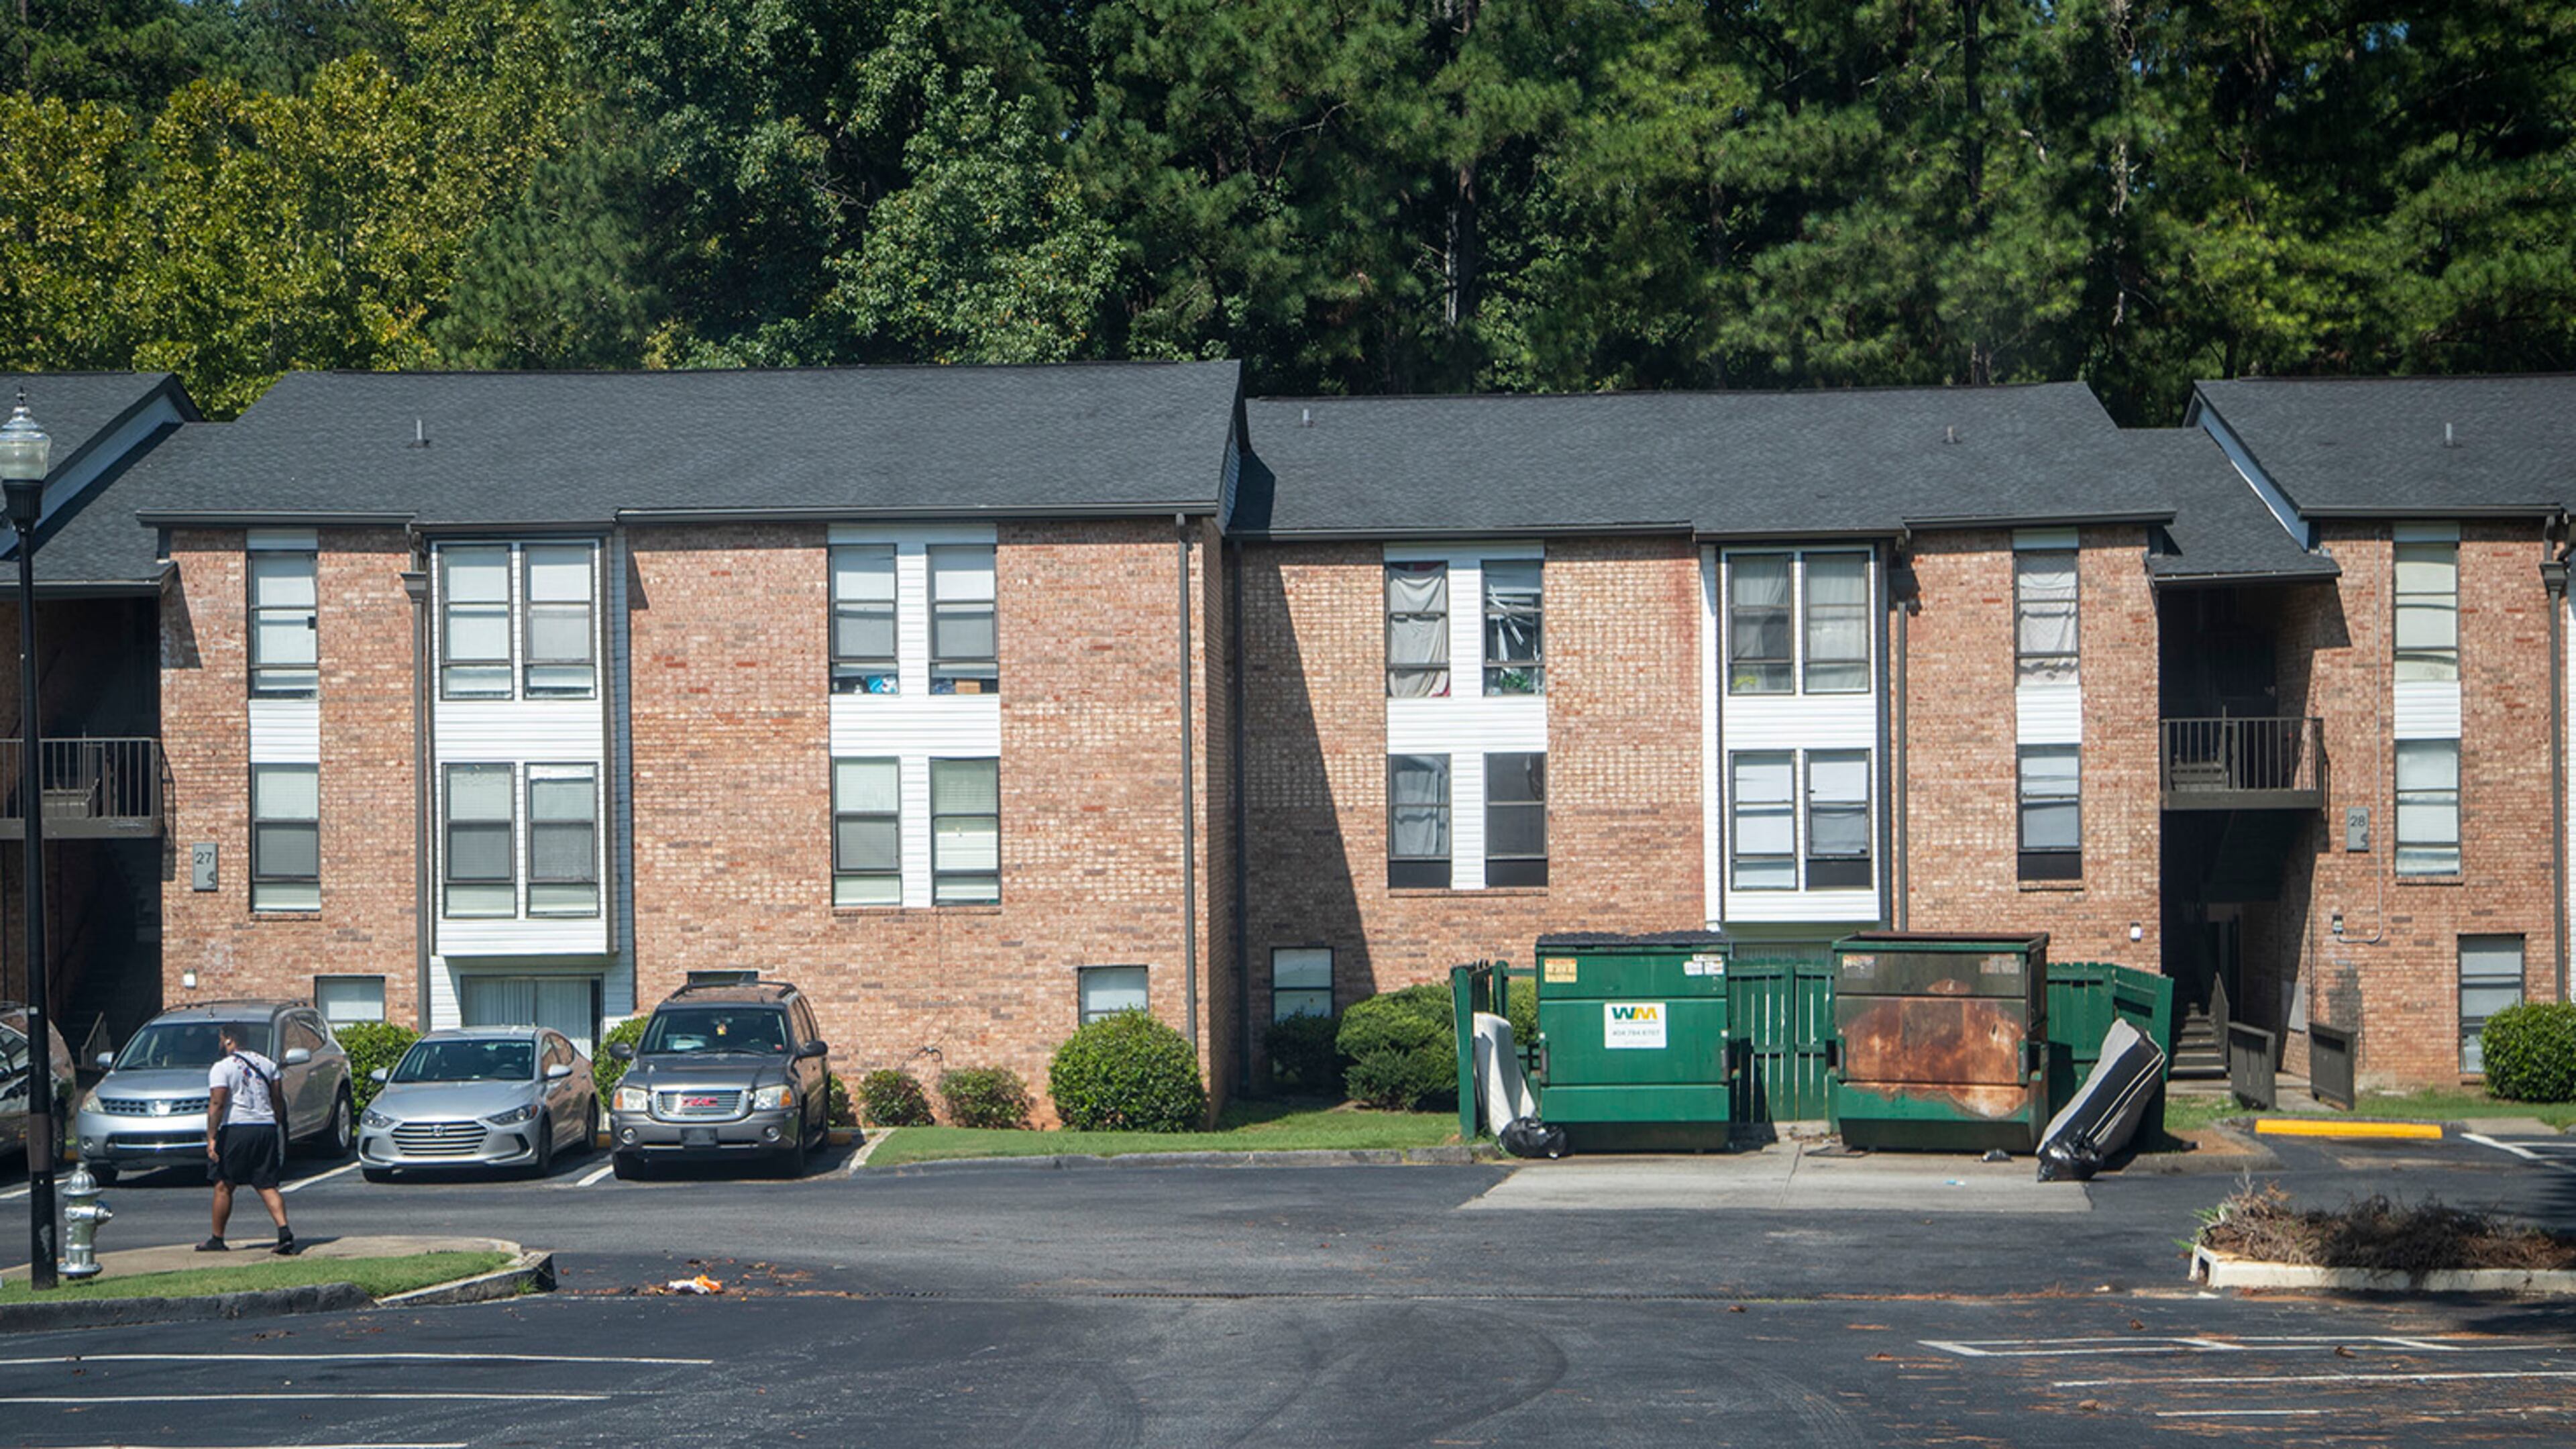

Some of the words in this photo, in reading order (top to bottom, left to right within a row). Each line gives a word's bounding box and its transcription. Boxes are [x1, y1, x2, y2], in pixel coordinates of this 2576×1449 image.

[2350, 814, 2366, 827] 28
[195, 851, 213, 864] 27
[1611, 1006, 1658, 1020] WM
